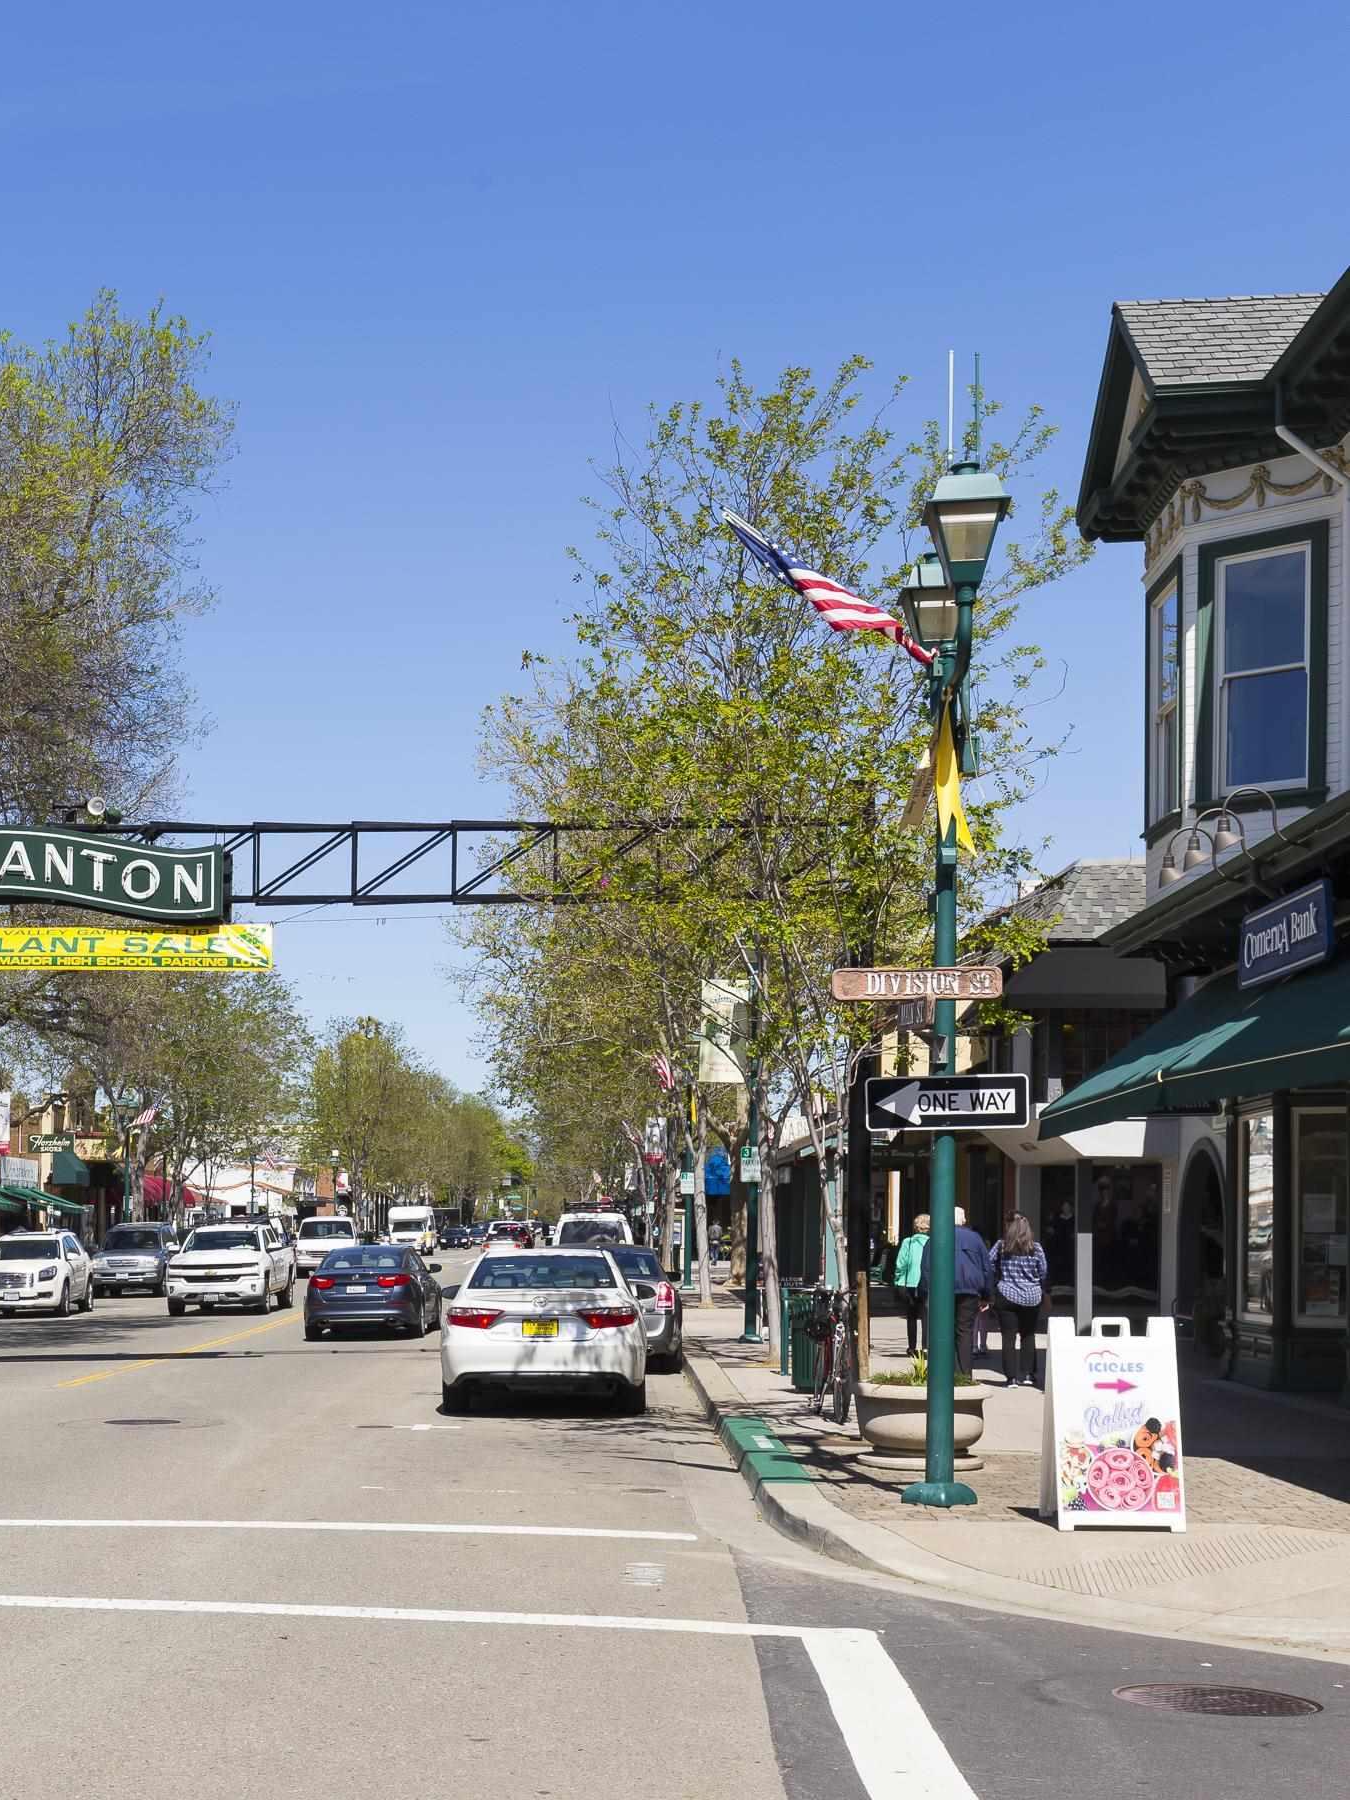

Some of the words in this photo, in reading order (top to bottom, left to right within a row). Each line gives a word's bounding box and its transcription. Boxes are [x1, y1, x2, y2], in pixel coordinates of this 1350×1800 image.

[1290, 902, 1318, 944] Bank
[120, 936, 230, 955] SALE
[56, 956, 91, 966] HIGH
[96, 957, 157, 967] SCHOOL
[161, 957, 228, 967] PARKING
[865, 971, 962, 995] DIVISION
[917, 1092, 960, 1113] ONE
[969, 1091, 1011, 1112] WAY
[1088, 1361, 1145, 1373] ICICLES
